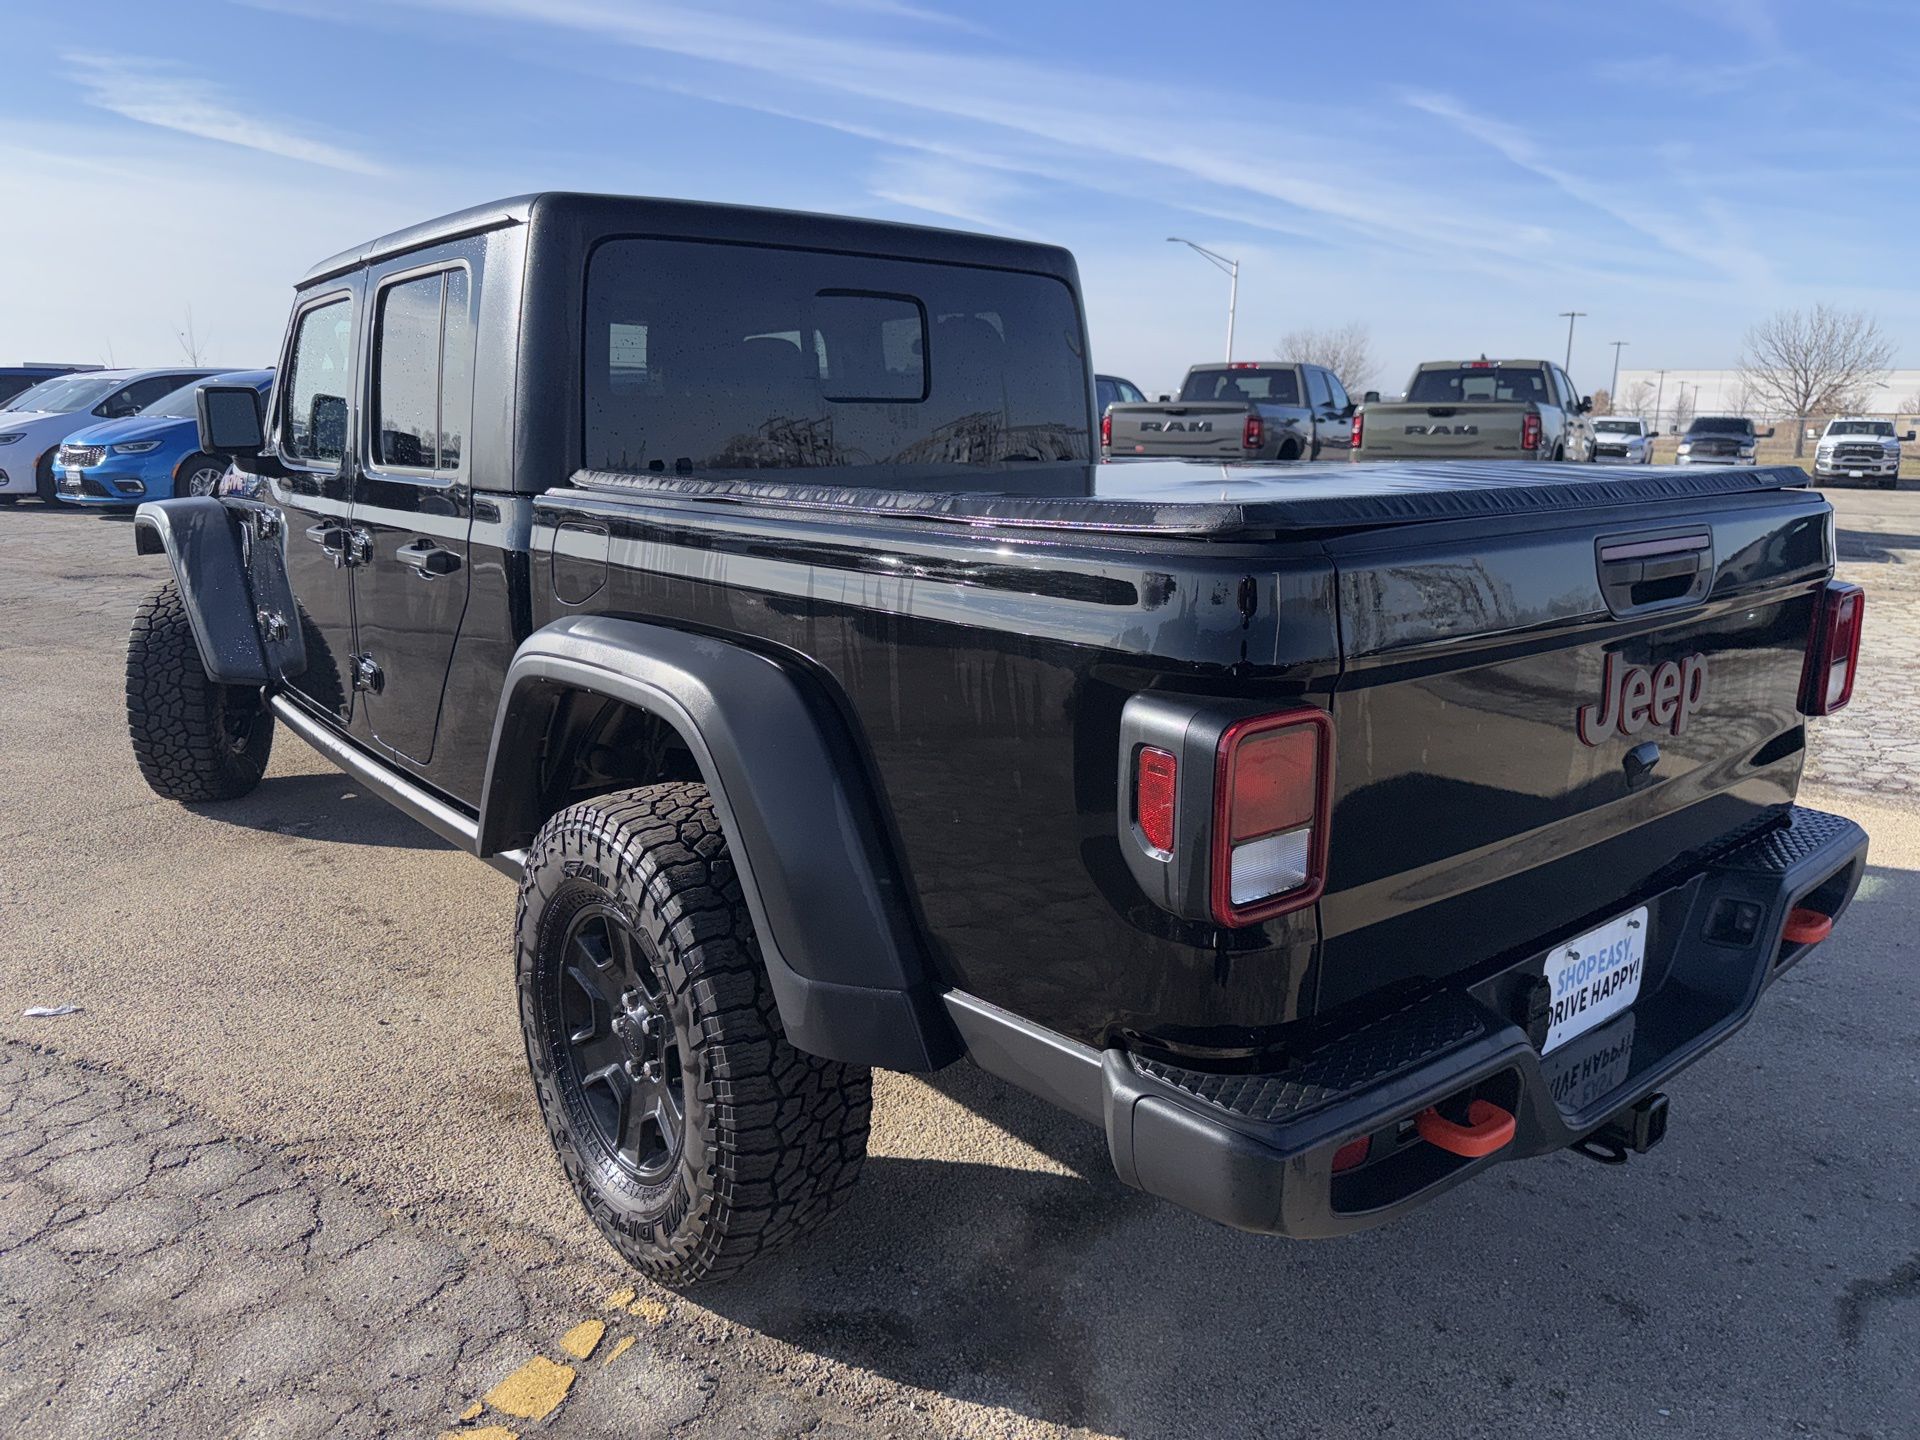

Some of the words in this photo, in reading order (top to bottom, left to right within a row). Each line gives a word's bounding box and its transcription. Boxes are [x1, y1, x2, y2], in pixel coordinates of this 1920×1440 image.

[1140, 421, 1212, 432] RAM
[1404, 425, 1478, 435] RAM
[1577, 652, 1708, 747] Jeep
[1557, 957, 1597, 996] SHOP
[1590, 958, 1641, 1005] HAPPY!
